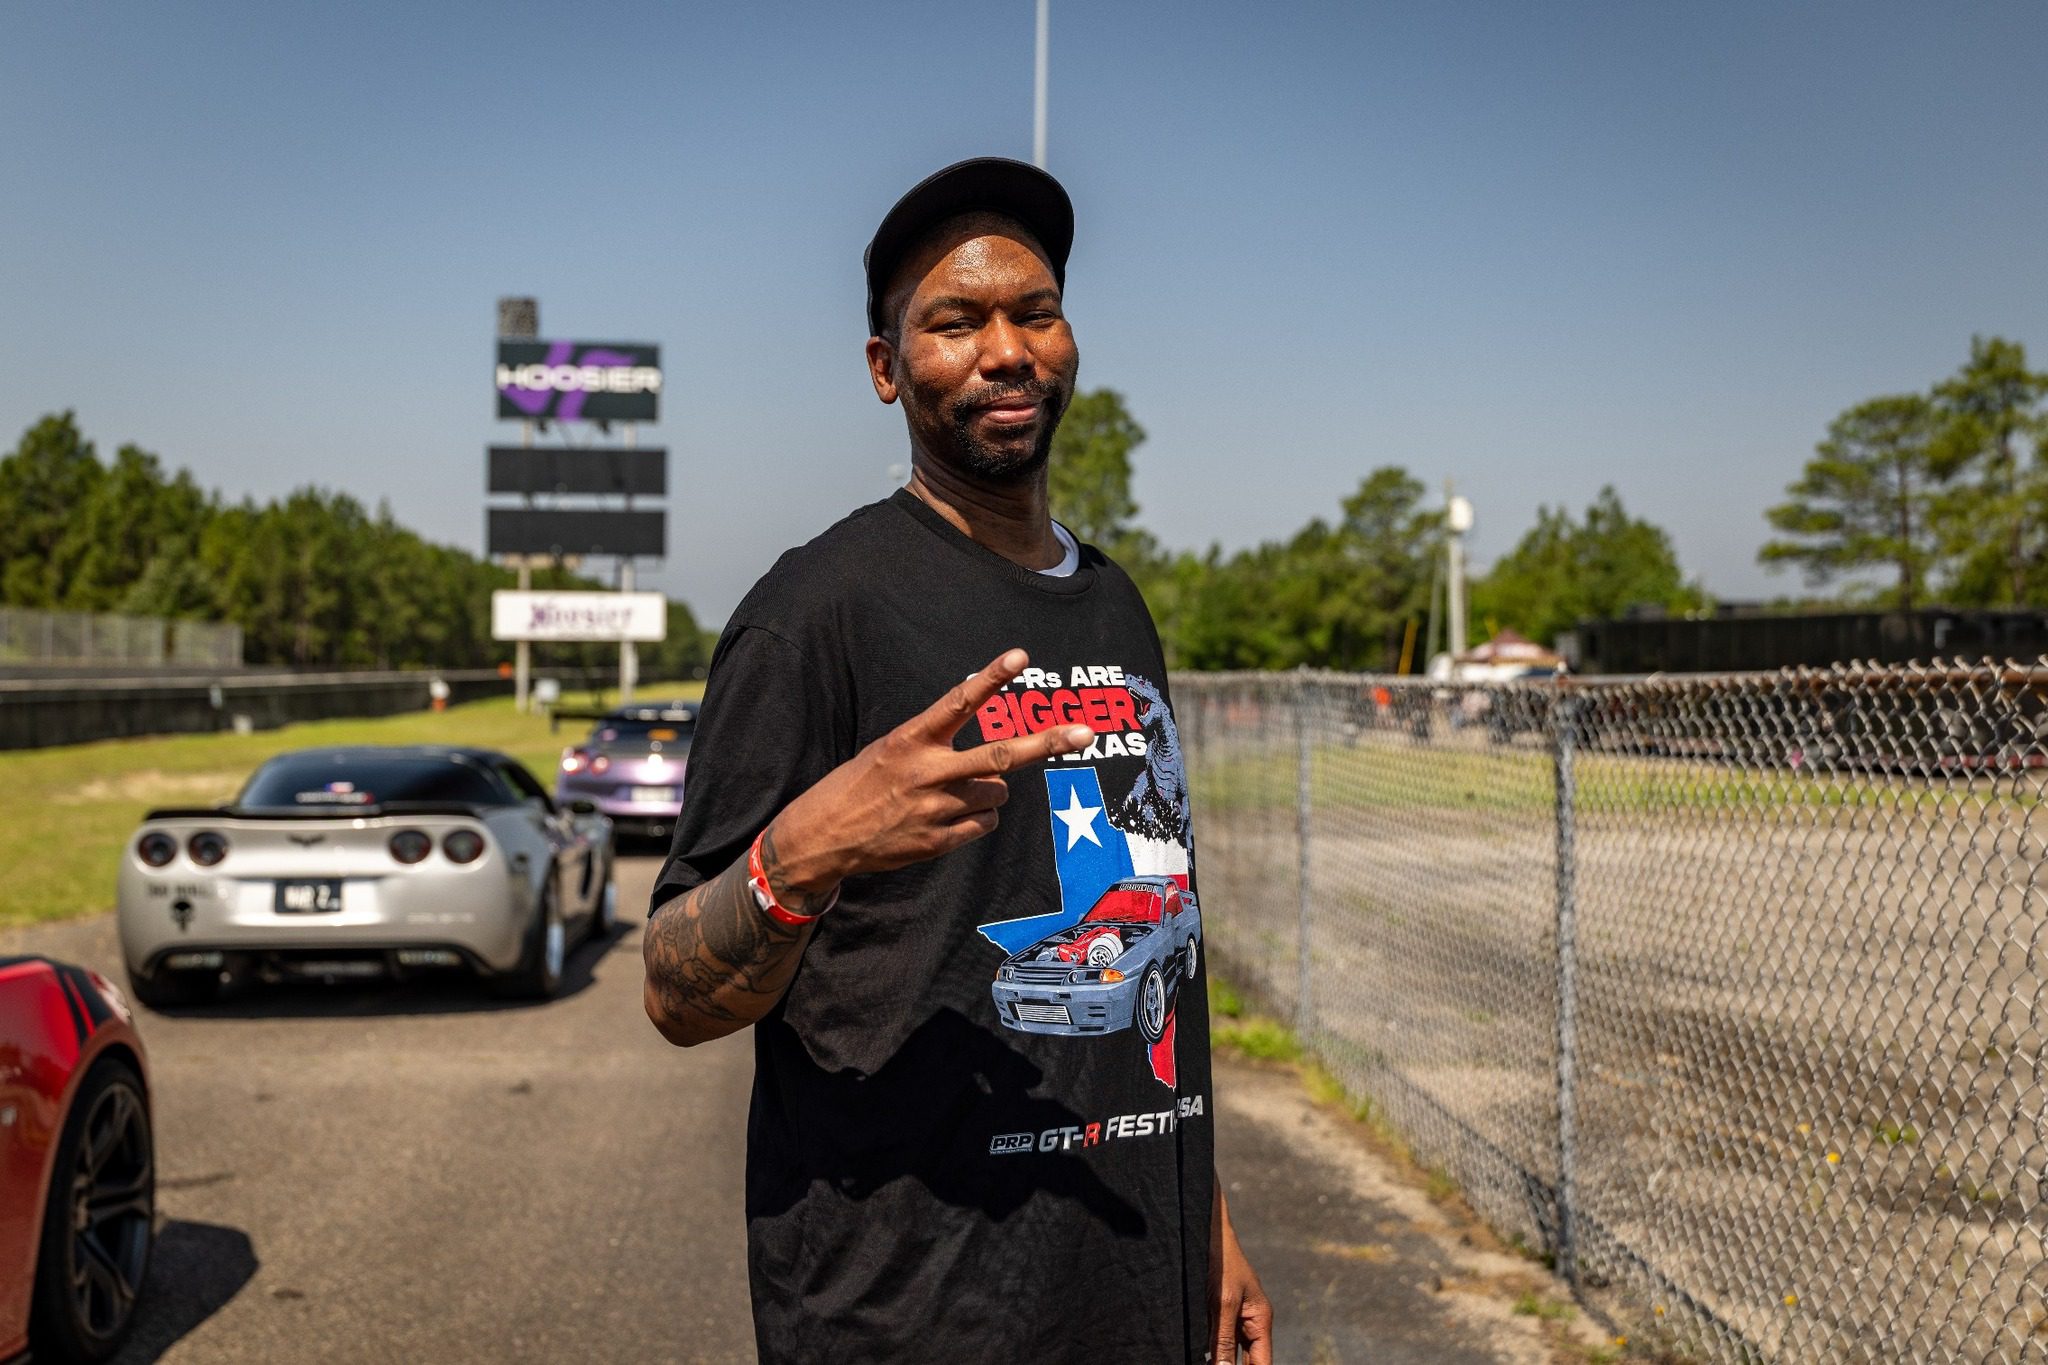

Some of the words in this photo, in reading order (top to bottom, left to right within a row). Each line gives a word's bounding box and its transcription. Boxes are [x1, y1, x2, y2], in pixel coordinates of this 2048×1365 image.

[967, 667, 1062, 691] -Rs
[1070, 665, 1125, 688] ARE
[976, 687, 1142, 742] BIGGER
[1047, 732, 1147, 761] XAS
[991, 1133, 1034, 1151] PRP
[1039, 1122, 1100, 1151] GT-R
[1105, 1109, 1177, 1141] FESTI
[1177, 1095, 1203, 1118] SA
